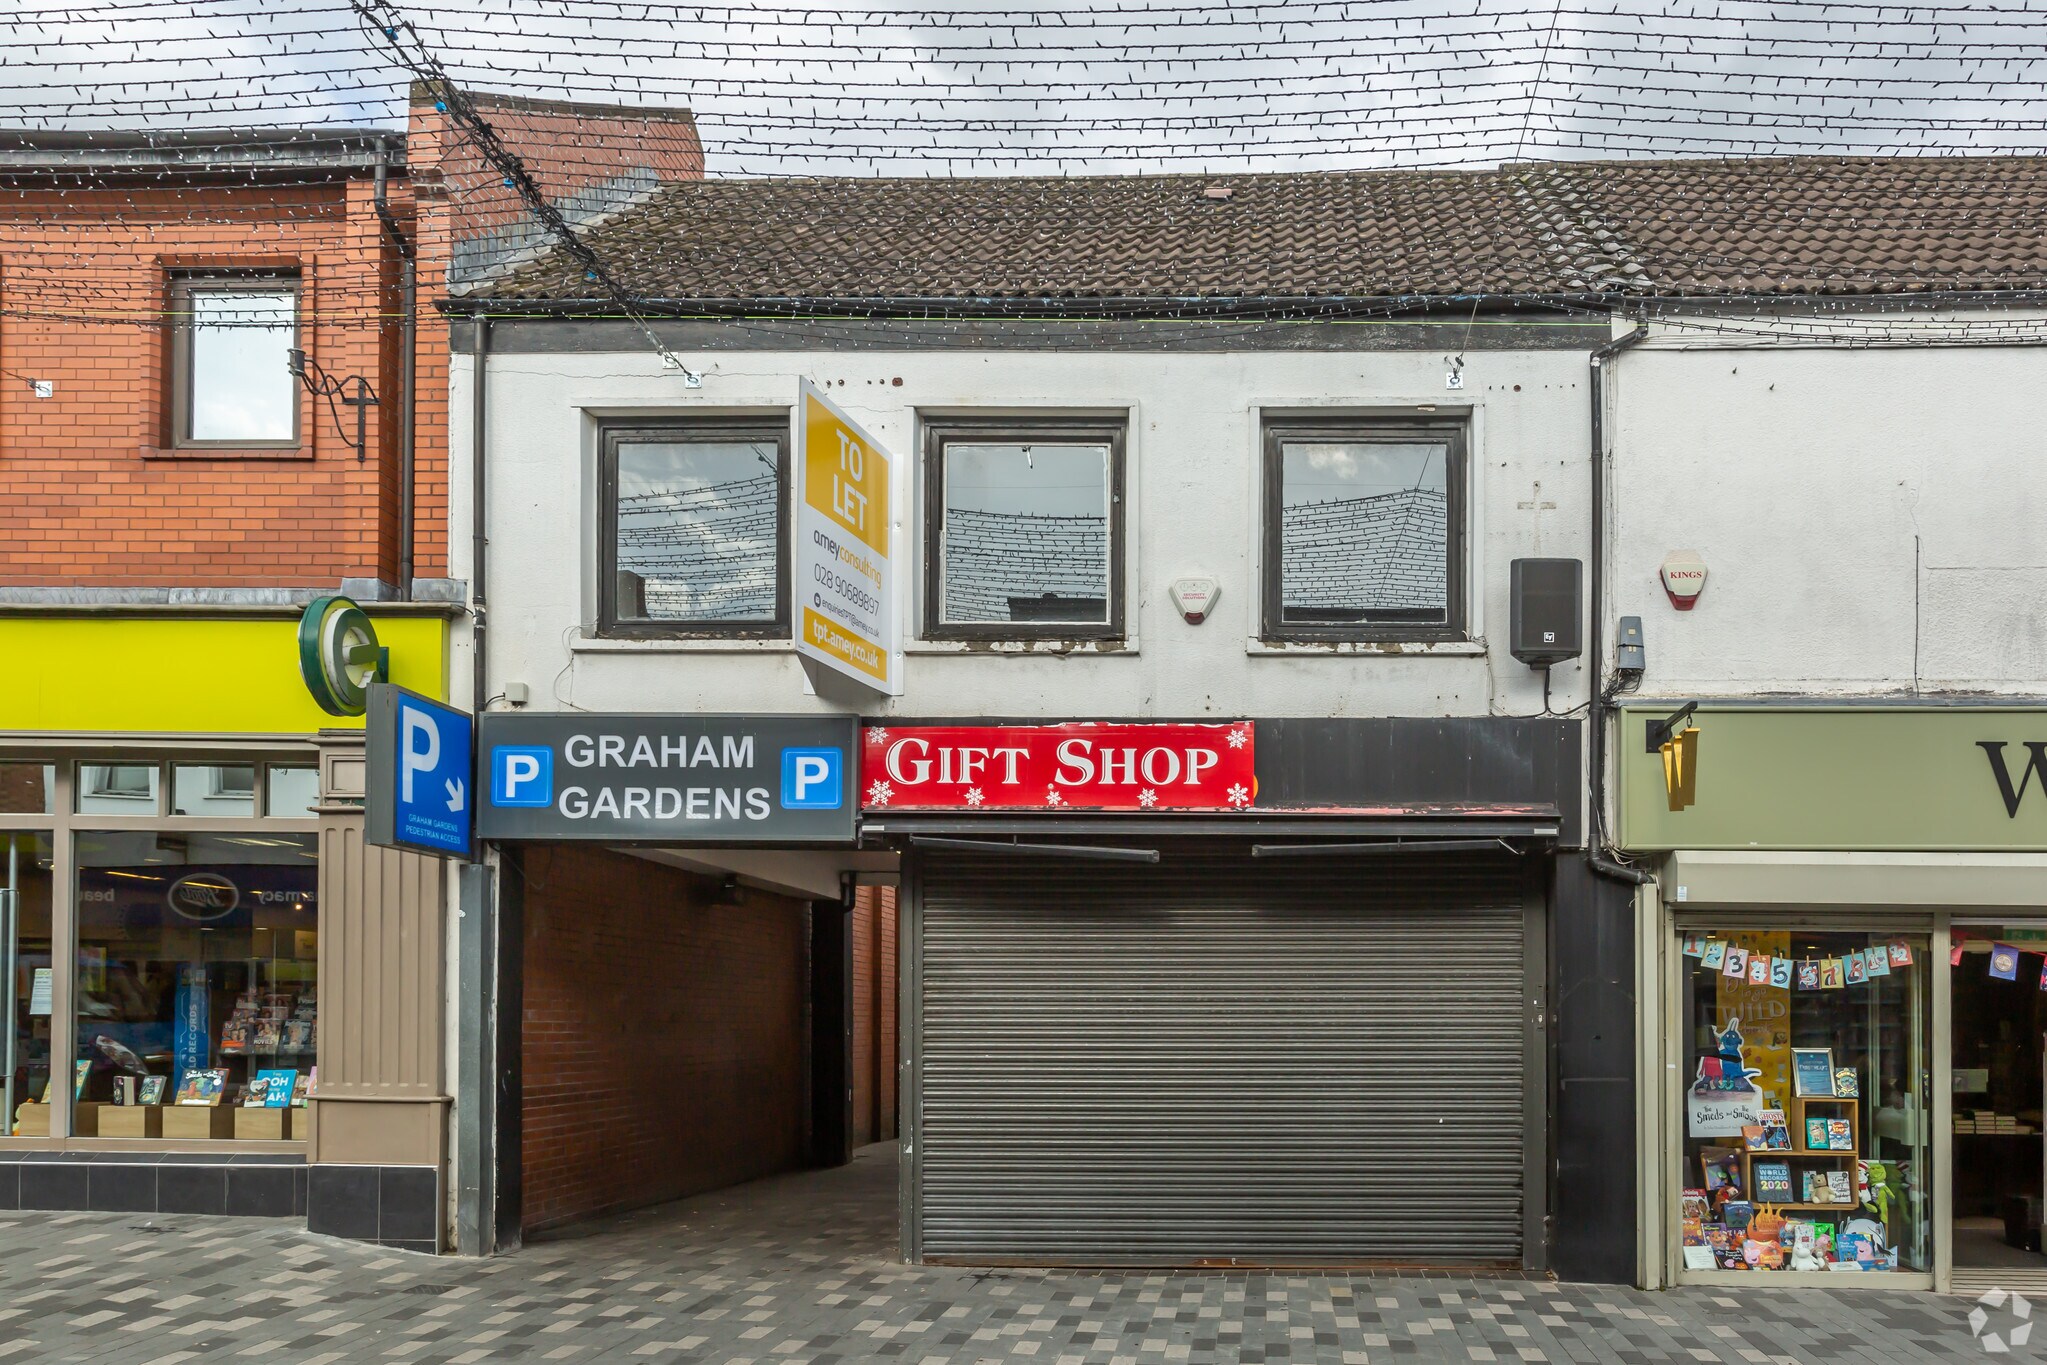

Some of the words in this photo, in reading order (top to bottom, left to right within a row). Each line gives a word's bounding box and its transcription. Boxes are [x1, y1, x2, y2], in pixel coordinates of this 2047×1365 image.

[836, 428, 863, 482] TO
[833, 473, 868, 531] LET
[814, 563, 834, 589] 028
[835, 575, 880, 617] 90689897
[1670, 571, 1702, 579] KINGS
[813, 618, 879, 669] tpt.amey.co.uk
[402, 705, 441, 804] P
[564, 734, 755, 768] GRAHAM
[885, 737, 1030, 786] GIFT
[1054, 738, 1219, 786] SHOP
[506, 754, 540, 798] P
[796, 757, 830, 800] P
[408, 814, 432, 826] GRAHAM
[433, 819, 458, 832] GARDENS
[558, 786, 771, 820] GARDENS
[405, 825, 439, 839] PEDESTRIAN
[441, 833, 461, 844] ACCESS
[1729, 955, 1744, 973] 3
[1773, 964, 1788, 984] 5
[188, 1004, 198, 1053] RECORDS
[1697, 1108, 1724, 1124] Smeds
[1761, 1180, 1789, 1190] 2020
